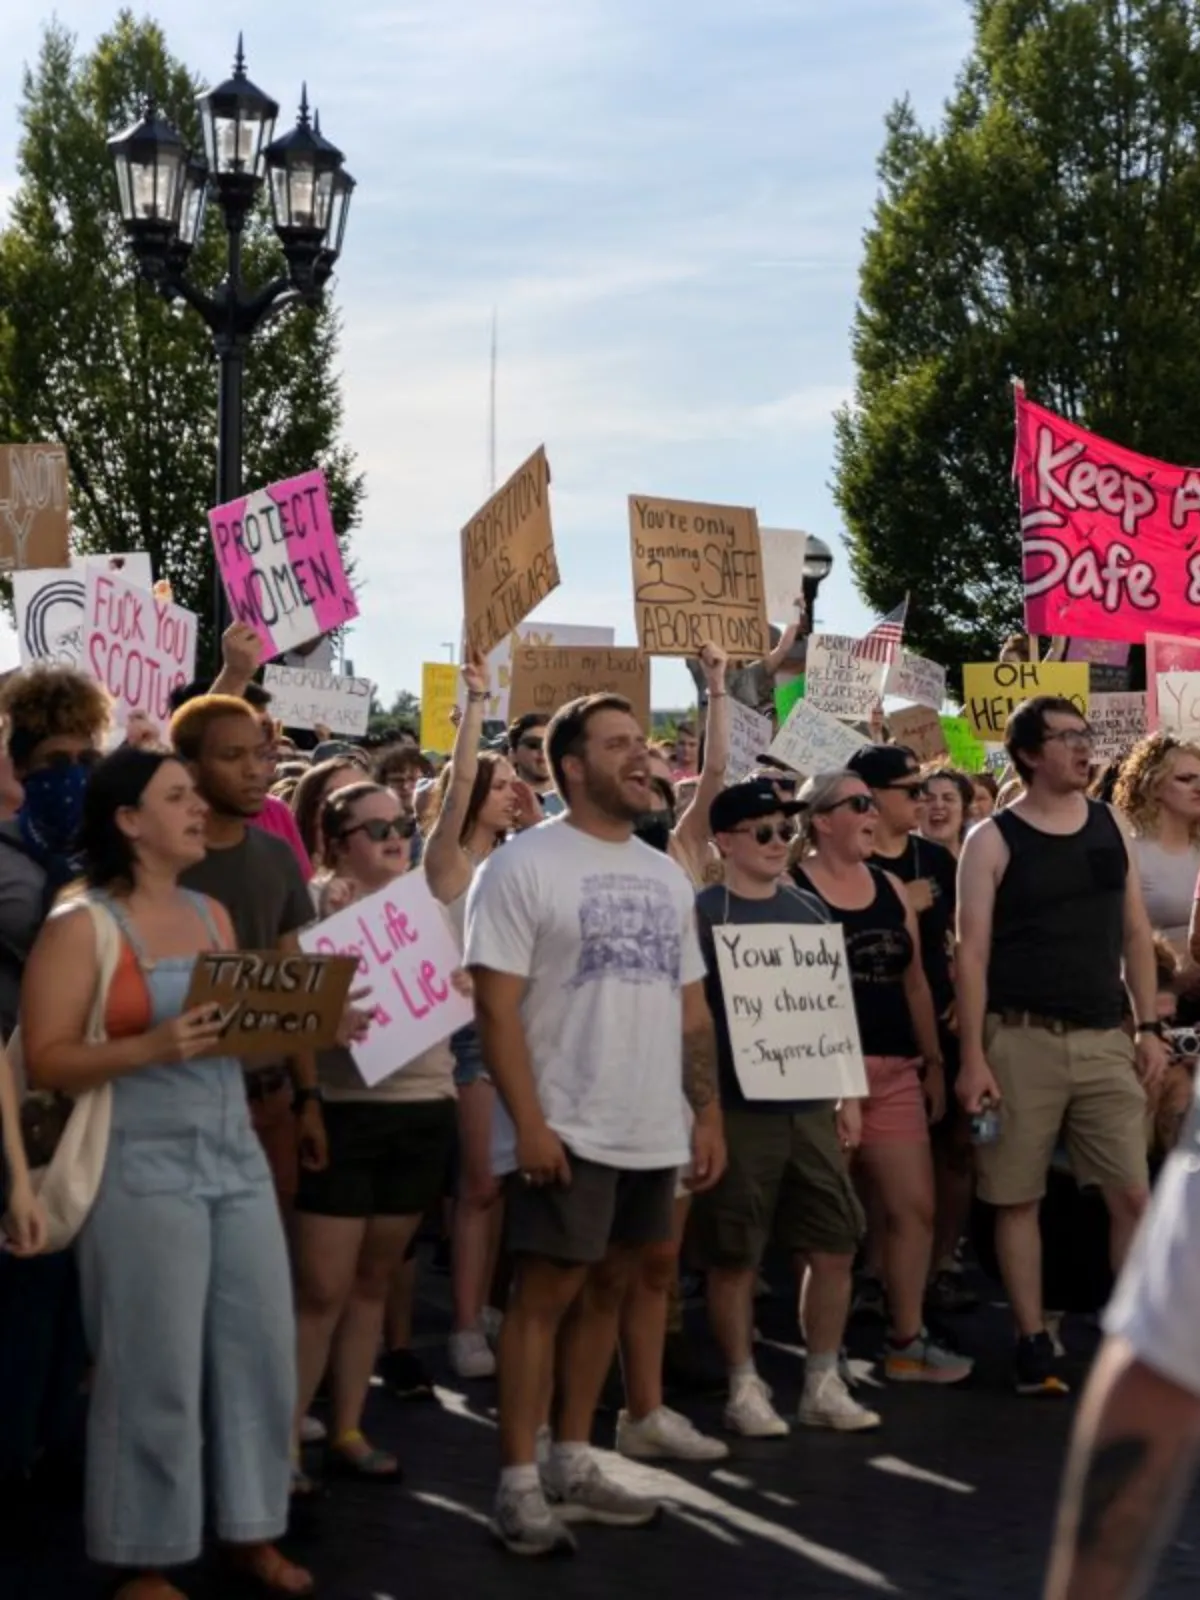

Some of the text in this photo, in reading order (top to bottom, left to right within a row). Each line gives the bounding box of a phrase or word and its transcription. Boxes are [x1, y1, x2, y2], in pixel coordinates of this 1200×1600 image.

[9, 447, 66, 511] NOT
[1036, 426, 1158, 535] Keep
[215, 487, 320, 567] PROTECT
[468, 460, 544, 573] ABORTION
[635, 501, 735, 547] You're only
[228, 551, 337, 626] WOMEN
[635, 538, 761, 603] banning SAFE
[1022, 509, 1160, 612] Safe
[94, 576, 188, 665] FUCK YOU
[643, 606, 764, 652] ABORTIONS
[994, 663, 1039, 689] OH
[204, 953, 327, 993] TRUST
[721, 933, 785, 969] Your
[392, 959, 449, 1020] Lie
[733, 994, 763, 1027] my
